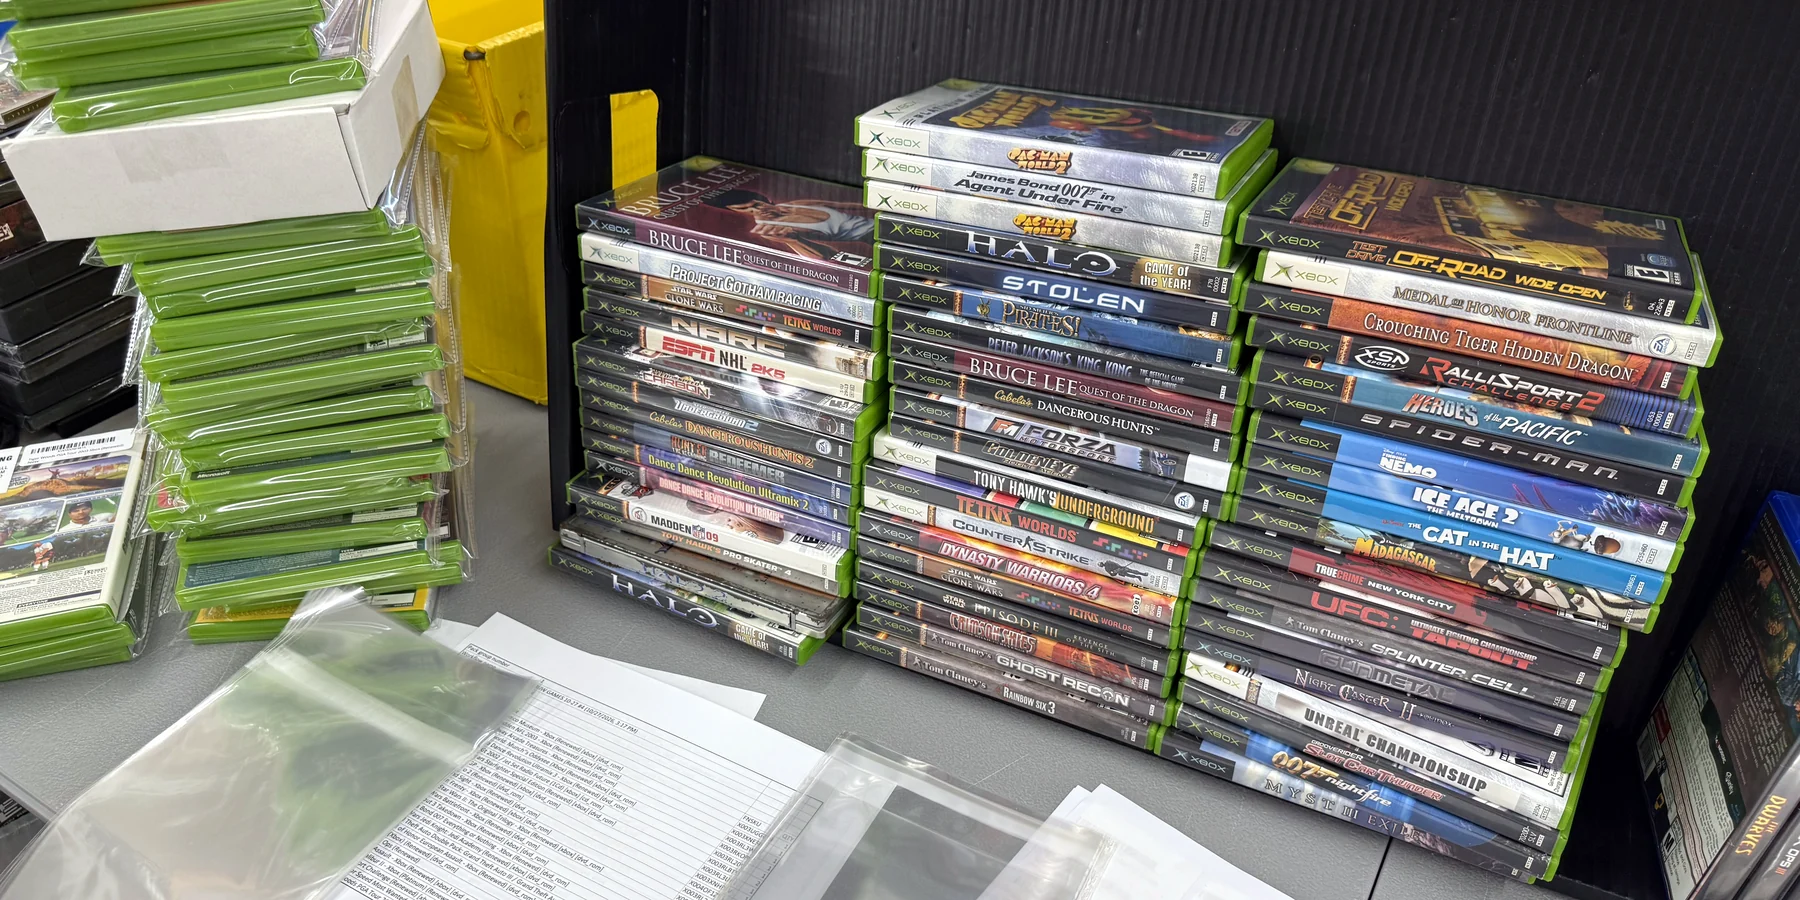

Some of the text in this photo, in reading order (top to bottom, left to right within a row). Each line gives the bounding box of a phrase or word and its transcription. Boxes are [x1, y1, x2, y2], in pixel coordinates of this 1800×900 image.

[886, 136, 920, 149] XBOX
[1007, 147, 1073, 167] PAC-MAN
[1018, 160, 1073, 174] WORLD 2
[953, 177, 1124, 214] Agent Under Fire
[966, 170, 1014, 186] James
[1017, 178, 1060, 192] Bond
[1100, 191, 1115, 202] in
[601, 222, 630, 235] XBOX
[649, 229, 742, 265] BRUCE LEE
[906, 226, 940, 239] XBOX
[1279, 234, 1320, 248] XBOX
[965, 230, 1120, 277] HALO
[1345, 250, 1385, 263] DRIVE
[1351, 241, 1388, 254] TEST
[743, 254, 839, 284] QUEST OF THE DRAGON
[1140, 274, 1192, 291] the YEAR!
[1144, 260, 1190, 277] GAME of
[1295, 269, 1339, 287] XBOX
[1392, 250, 1608, 301] OFF-ROAD WIDE OPEN
[665, 293, 724, 314] CLONE WARS
[670, 263, 821, 312] PROJECT GOTHAM RACING
[1002, 275, 1145, 314] STOLEN
[1001, 298, 1082, 338] PIRATES!
[1392, 287, 1451, 309] MEDAL
[1465, 299, 1532, 323] HONOR
[1534, 312, 1633, 346] FRONTLINE
[662, 336, 785, 380] ESPN NHL 2K5
[988, 337, 1021, 355] PETER
[1022, 343, 1073, 366] JACKSON'S
[1076, 354, 1102, 371] KING
[1103, 361, 1133, 379] KONG
[1363, 311, 1634, 382] CROUCHING TIGER HIDDEN DRAGON
[994, 388, 1154, 436] Cabela's DANGEROUS HUNTS
[1447, 378, 1573, 410] CHALLENGE
[1576, 391, 1607, 412] 2
[1401, 392, 1583, 446] HEROES of the PACIFIC
[1025, 425, 1118, 457] FORZA
[1360, 412, 1619, 481] SPIDER-MAN
[196, 470, 231, 479] Microsoft
[648, 454, 676, 472] Dance
[677, 463, 705, 480] Dance
[707, 473, 756, 496] Revolution
[758, 486, 799, 507] Ultramix
[802, 499, 809, 510] 2
[1379, 456, 1437, 479] NEMO
[956, 494, 1077, 543] TETRIS WORLDS
[973, 470, 1155, 534] TONY HAWK'S UNDERGROUND
[1412, 487, 1520, 525] ICE AGE 2
[1426, 505, 1499, 529] THE MELTDOWN
[651, 515, 719, 542] MADDEN 09
[952, 518, 1090, 565] COUNTER STRIKE
[1407, 521, 1422, 530] THE
[1421, 526, 1470, 548] CAT
[1468, 538, 1481, 548] IN
[1482, 540, 1500, 552] THE
[1498, 546, 1555, 572] HAT
[661, 531, 683, 544] TONY
[685, 537, 722, 554] HAWK'S
[723, 550, 742, 560] PRO
[743, 556, 778, 573] SKATER
[940, 540, 1100, 600] DYNASTY WARRIORS 4
[1353, 537, 1438, 574] MADAGASCAR
[611, 573, 720, 629] HALO
[940, 573, 1004, 598] CLONE WARS
[1367, 580, 1390, 592] NEW
[1391, 587, 1425, 604] YORK
[1426, 595, 1454, 612] CITY
[1310, 590, 1399, 630] UFC:
[1410, 619, 1538, 662] ULTIMATE FIGHTING CHAMPIONSHIP
[924, 662, 987, 690] Tom Clancy's
[939, 636, 956, 648] Tom
[958, 642, 992, 660] Clancy's
[995, 653, 1061, 683] GHOST
[1063, 675, 1130, 707] RECON
[1296, 620, 1536, 699] Tom Clancy's SPLINTER CELL
[1003, 686, 1056, 714] RAINBOW SIX 3
[519, 720, 540, 732] Museum
[543, 731, 555, 739] Xbox
[1304, 707, 1488, 793] UNREAL CHAMPIONSHIP
[1311, 739, 1364, 761] GROOVERIDER
[1303, 743, 1443, 800] SLOT CAR THUNDER
[1264, 777, 1336, 812] MYST
[1341, 805, 1358, 819] III
[1324, 776, 1393, 808] nightfire
[742, 815, 762, 827] FNSKU
[1735, 794, 1787, 856] DWARVES
